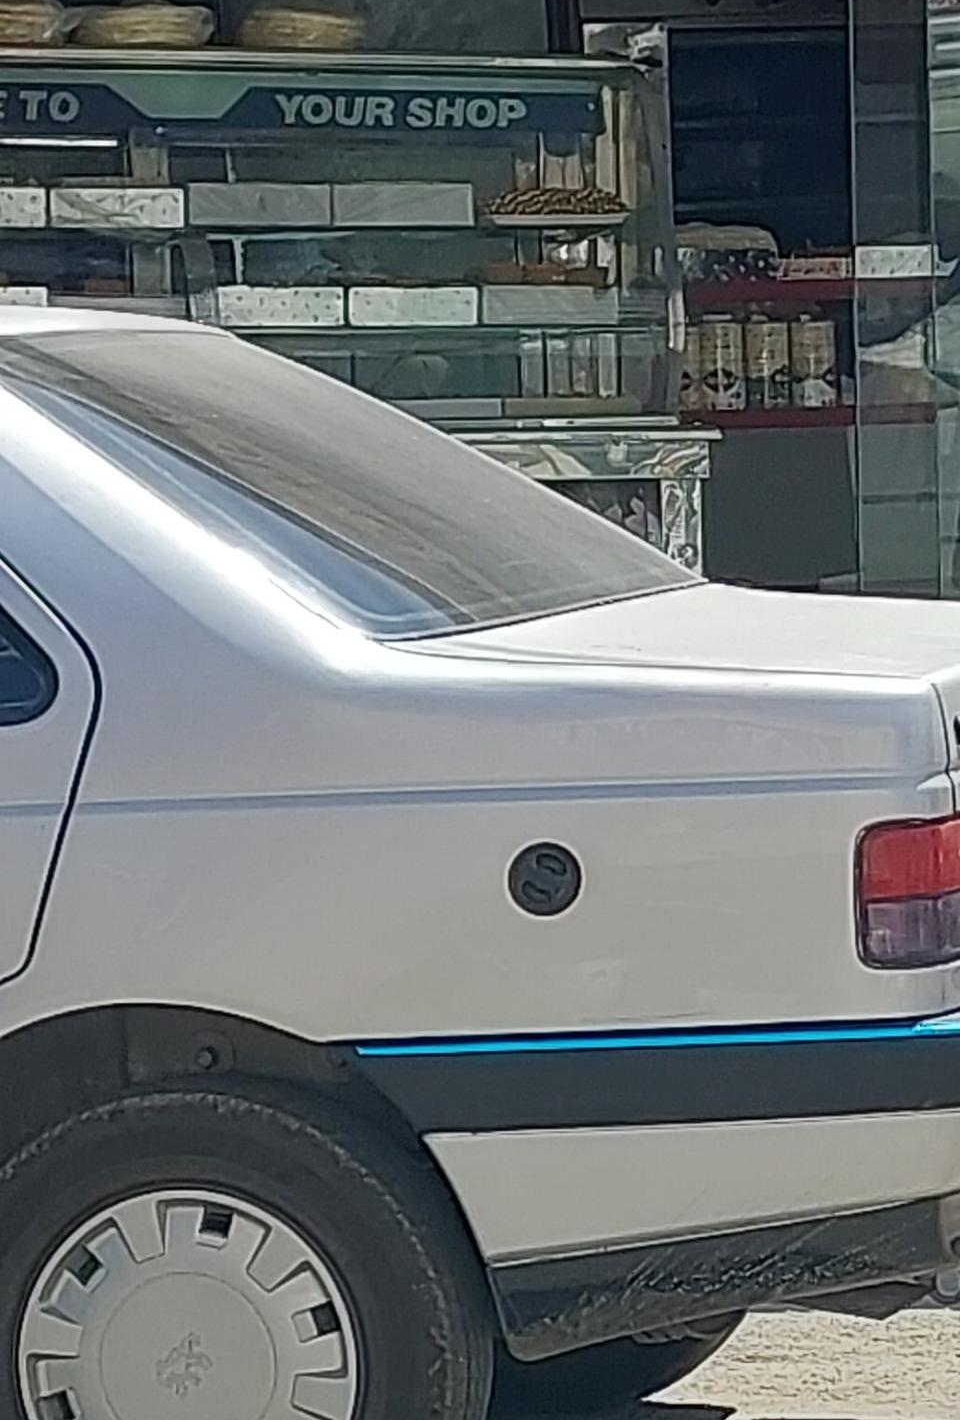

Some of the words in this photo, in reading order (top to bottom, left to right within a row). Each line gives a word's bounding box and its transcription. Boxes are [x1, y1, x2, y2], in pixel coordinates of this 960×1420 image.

[19, 89, 80, 122] TO
[275, 84, 396, 127] YOUR
[405, 96, 527, 129] SHOP
